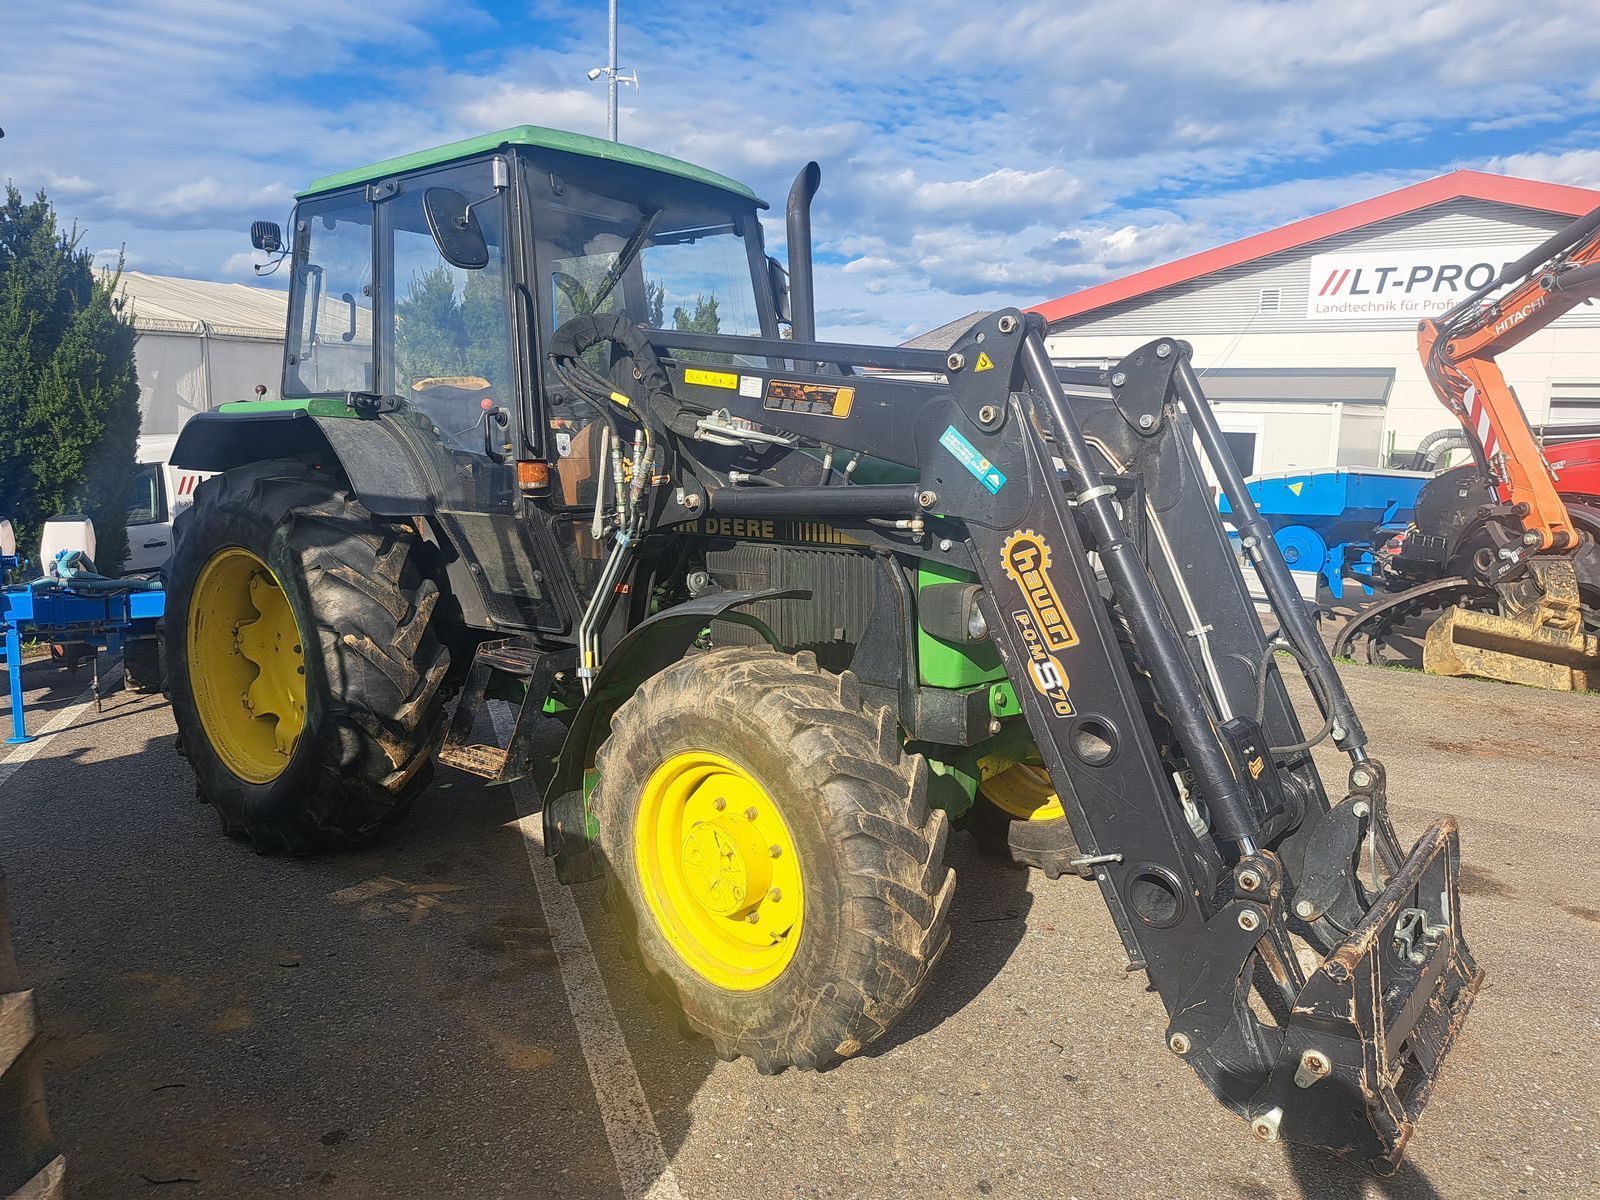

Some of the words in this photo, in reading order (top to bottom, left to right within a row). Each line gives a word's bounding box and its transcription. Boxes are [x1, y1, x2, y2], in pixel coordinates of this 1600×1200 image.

[1349, 262, 1532, 295] LT-PRO
[1316, 301, 1396, 313] Landtechnik
[1401, 300, 1419, 311] für
[1495, 295, 1545, 334] HITACHI
[706, 518, 774, 538] DEERE
[1012, 547, 1070, 640] hauer
